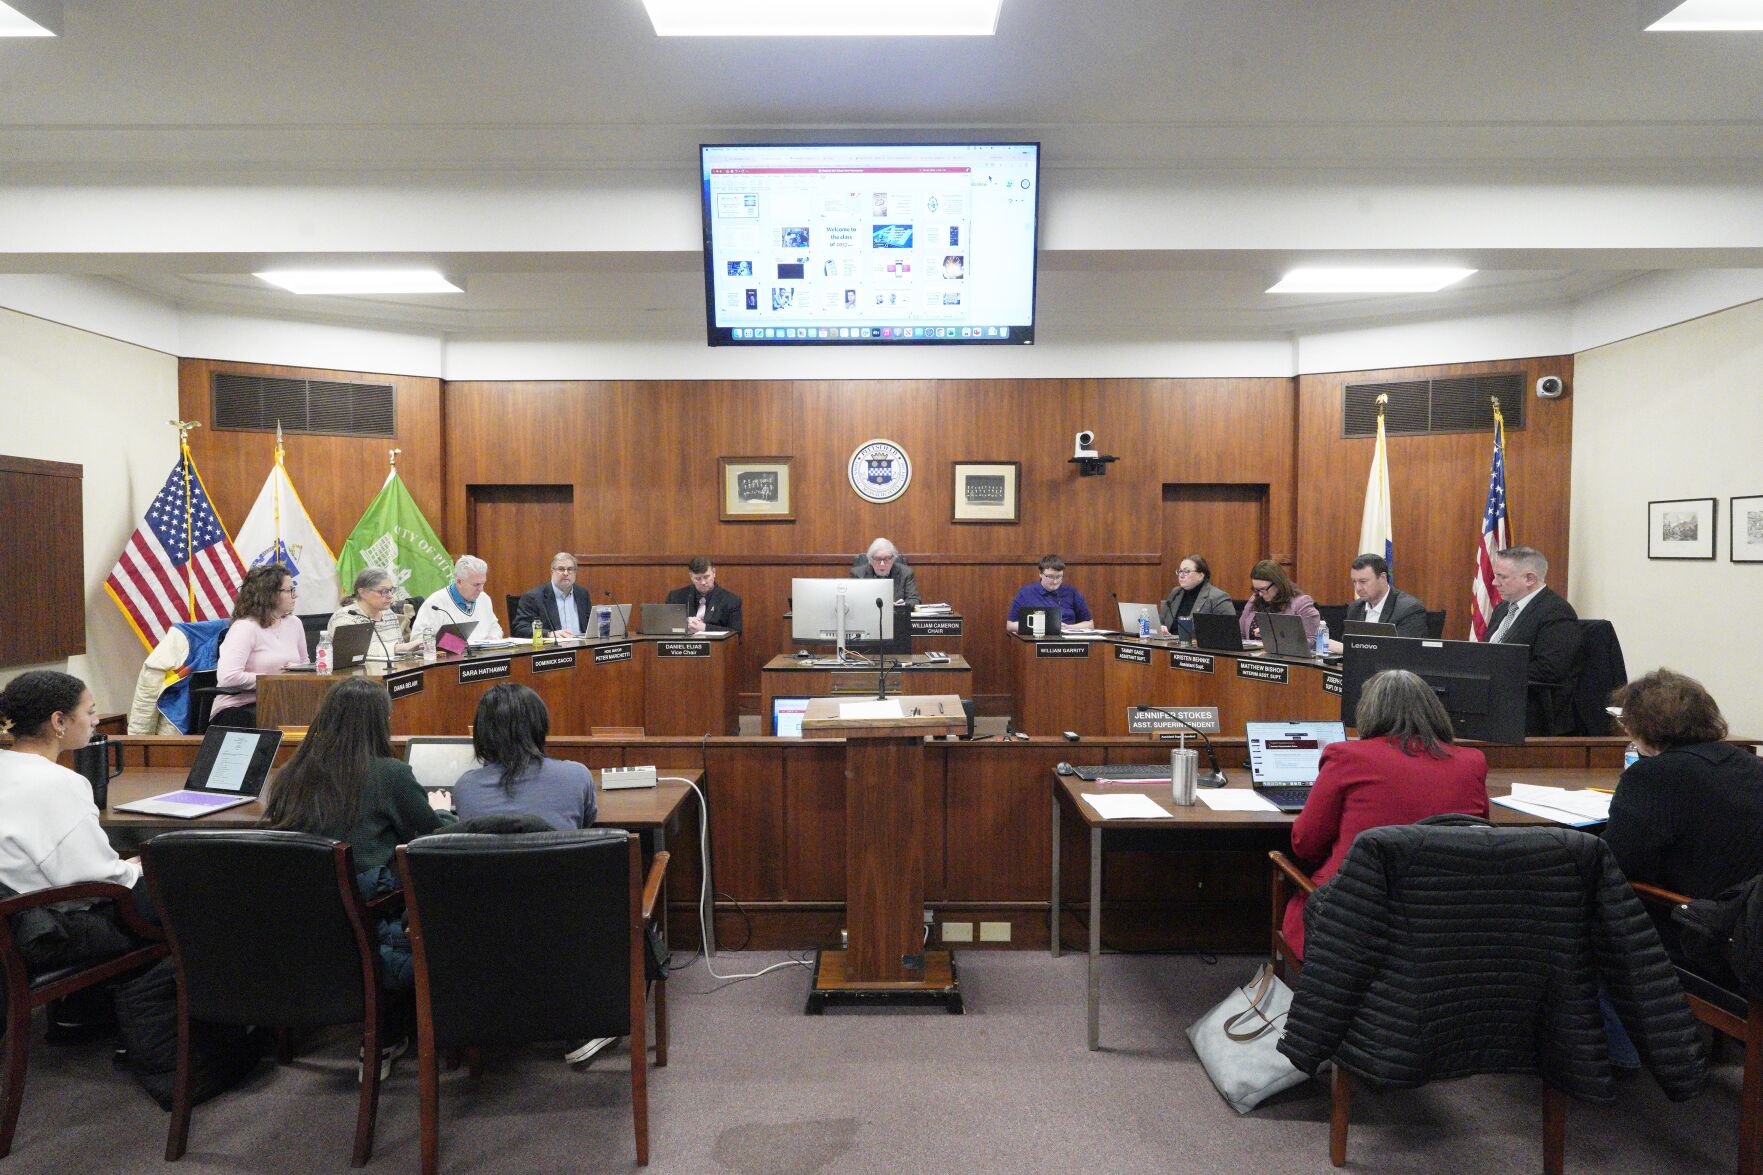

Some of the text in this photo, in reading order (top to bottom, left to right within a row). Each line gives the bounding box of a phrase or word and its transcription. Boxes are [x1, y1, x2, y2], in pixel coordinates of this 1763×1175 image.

[394, 525, 418, 542] CTY
[418, 539, 436, 553] OF
[1351, 642, 1378, 650] Lenovo
[608, 652, 630, 660] MARCHETTI
[1173, 654, 1192, 662] KRISTEN
[535, 656, 573, 667] DOMINICK SACCO
[462, 665, 508, 678] SARA HATHAWAY
[1240, 662, 1284, 673] MATTHEW BISHOP
[393, 683, 405, 692] DANA
[1134, 711, 1212, 719] JENNIFER STOKES
